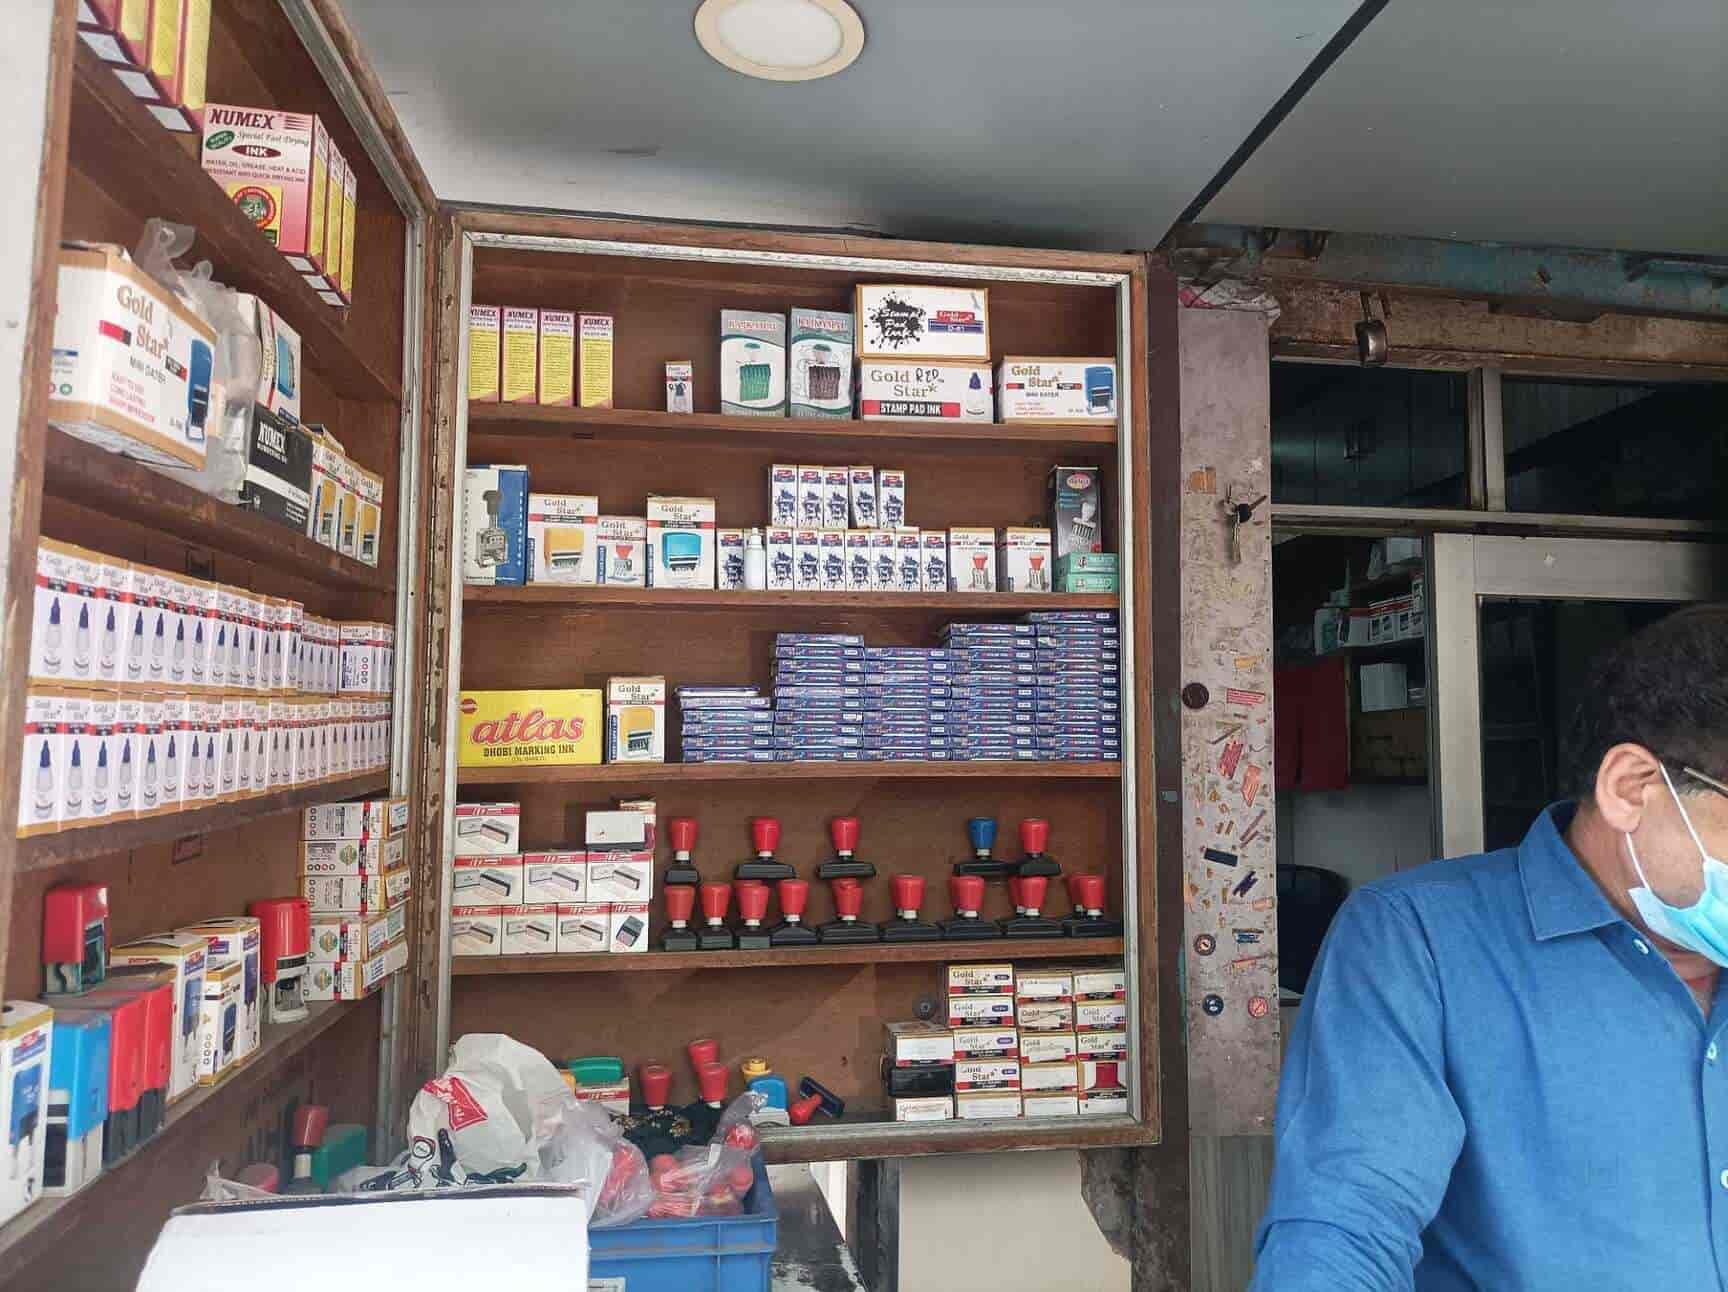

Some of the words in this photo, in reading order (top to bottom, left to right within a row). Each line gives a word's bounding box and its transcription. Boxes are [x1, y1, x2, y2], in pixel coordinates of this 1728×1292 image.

[209, 109, 274, 130] NUMEX
[246, 146, 267, 157] INK
[117, 285, 154, 324] Gold
[136, 324, 166, 360] Star
[871, 370, 910, 383] Gold
[1011, 366, 1040, 377] Gold
[1028, 376, 1053, 388] Star
[894, 384, 929, 397] Star
[881, 403, 907, 414] STAMP
[909, 404, 926, 415] PAD
[927, 404, 942, 416] INK
[258, 421, 286, 455] NUMEX
[545, 499, 567, 507] Gold
[556, 507, 576, 516] Star
[661, 504, 684, 513] Gold
[674, 512, 693, 521] Star
[602, 521, 626, 530] Gold
[619, 685, 641, 693] Gold
[471, 708, 585, 744] atlas
[484, 747, 512, 757] DHOBI
[514, 745, 556, 756] MARKING
[558, 744, 575, 754] INK
[953, 969, 974, 978] Gold
[954, 1003, 973, 1011] Gold
[1083, 1008, 1100, 1016] Gold
[959, 1036, 978, 1044] Gold
[1080, 1036, 1098, 1044] Gold
[972, 1073, 991, 1081] Star
